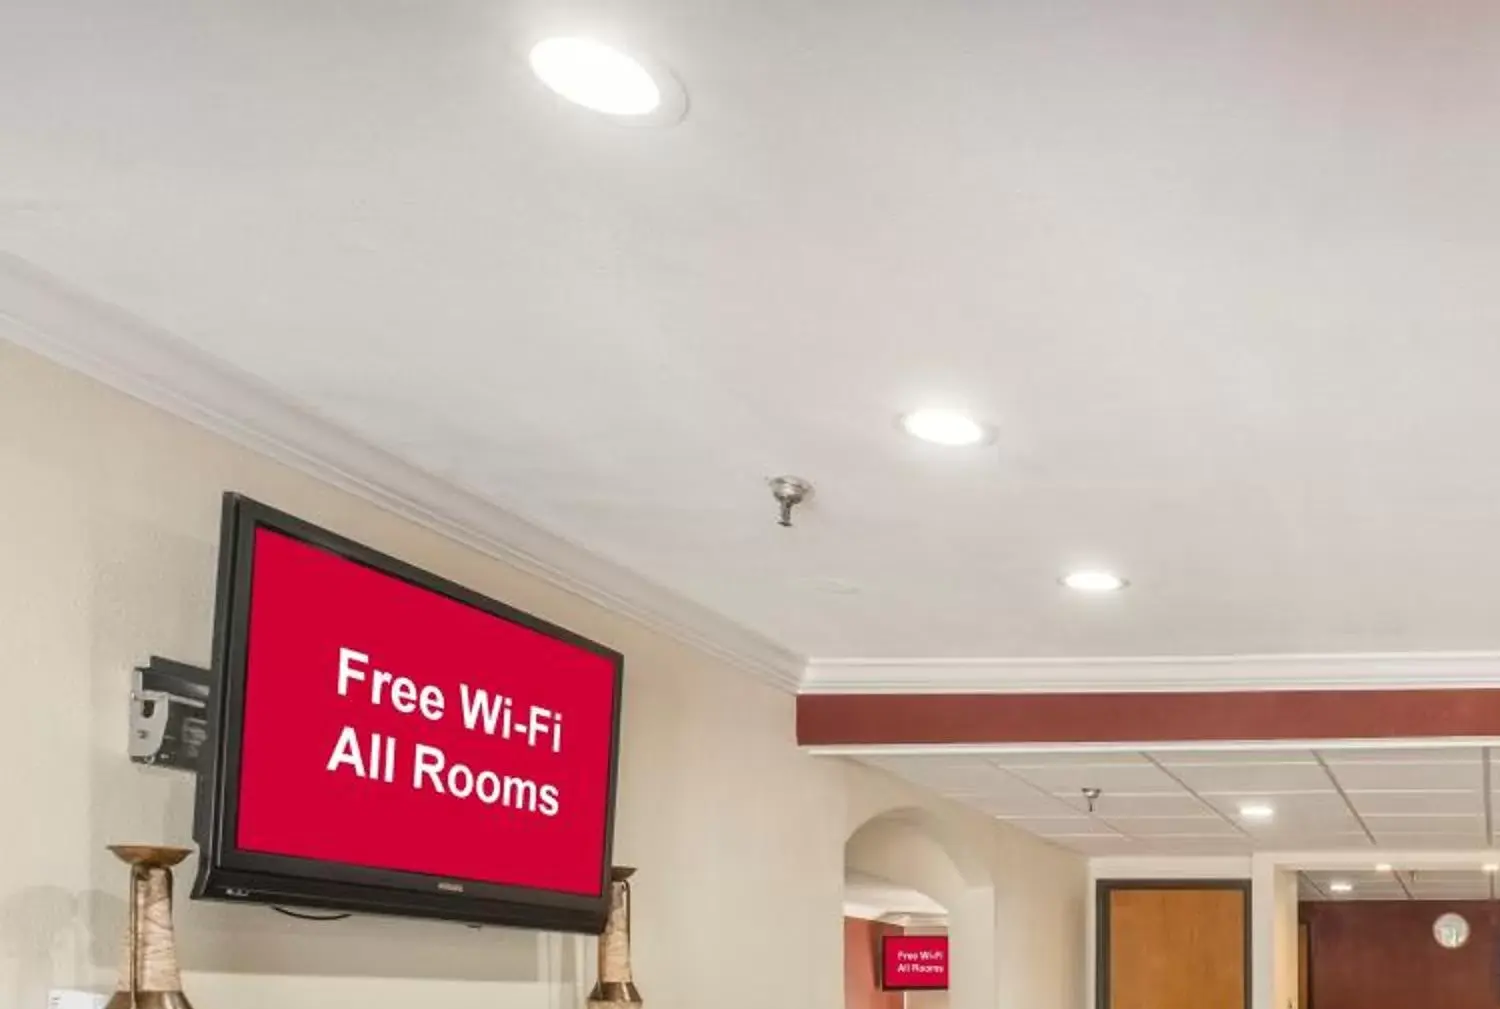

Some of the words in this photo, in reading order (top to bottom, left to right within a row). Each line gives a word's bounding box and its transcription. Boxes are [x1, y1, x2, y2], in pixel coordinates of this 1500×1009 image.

[337, 647, 445, 721] Free
[459, 683, 562, 753] Wi-Fi
[326, 726, 396, 783] All
[413, 743, 559, 816] Rooms
